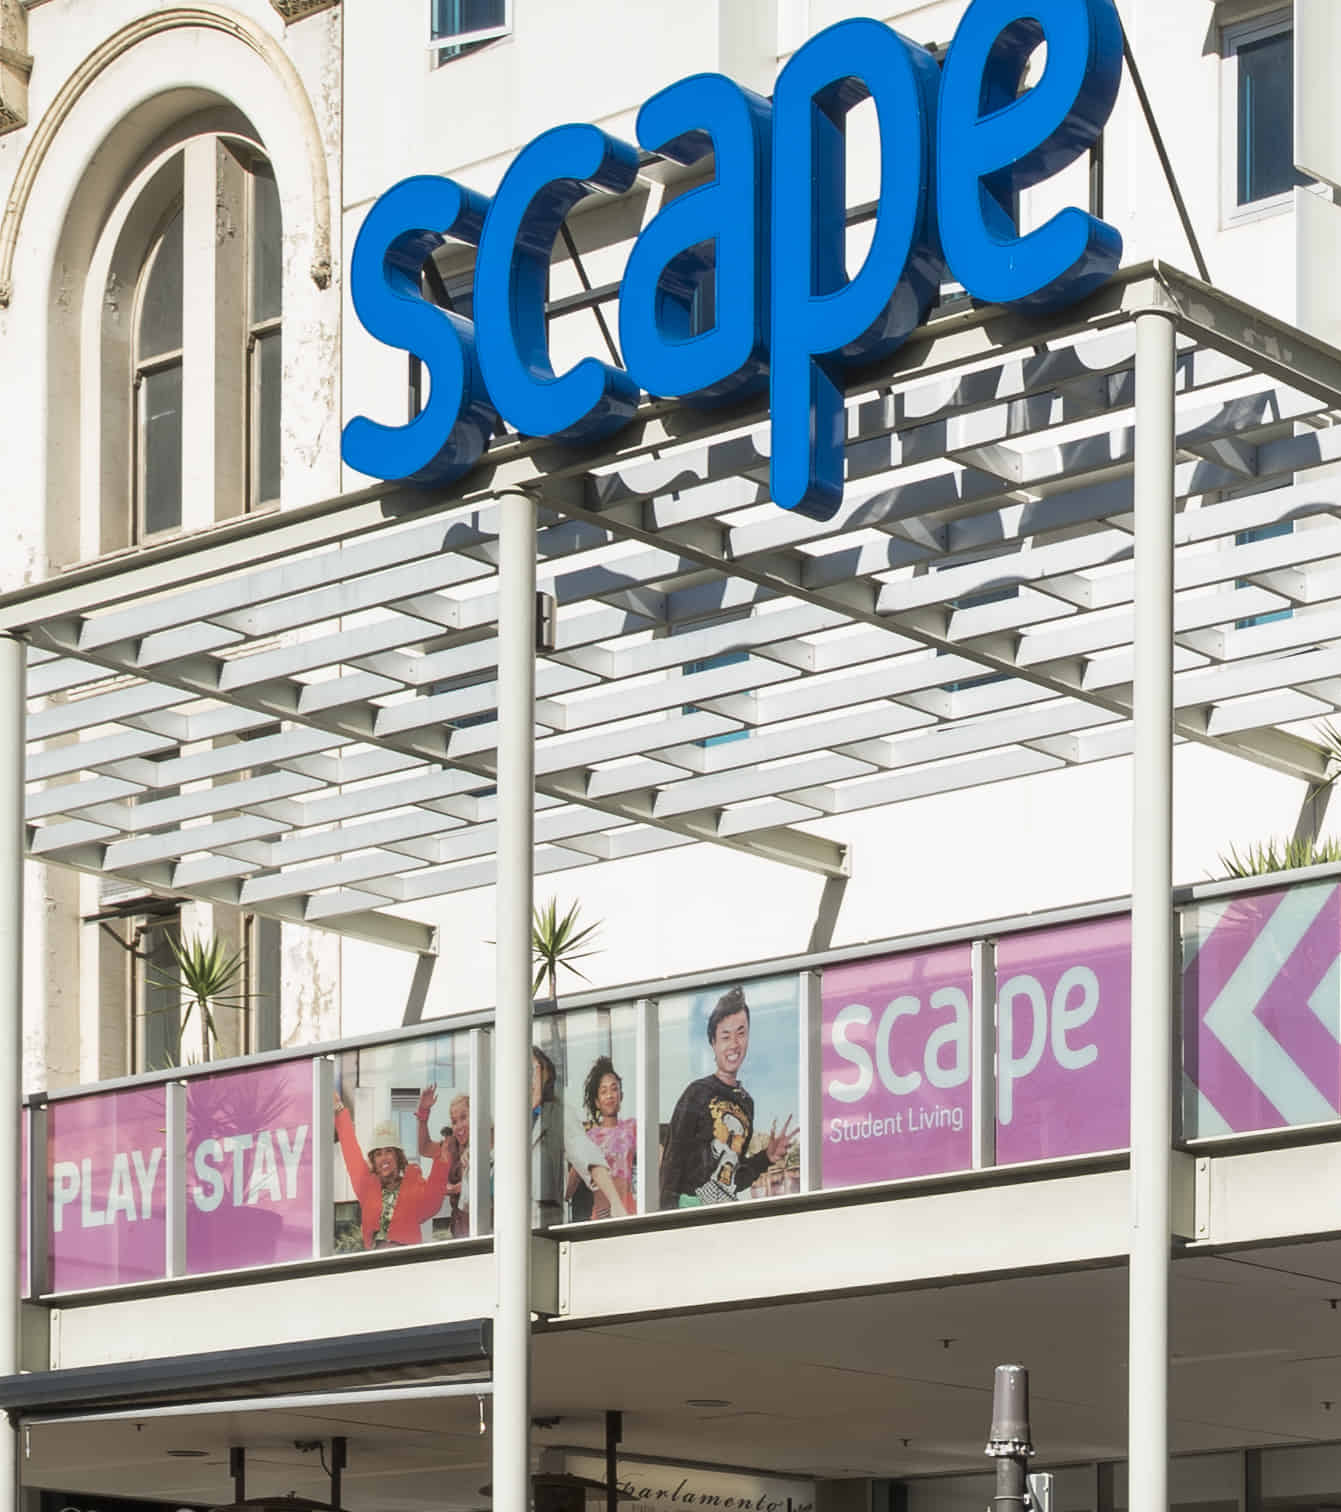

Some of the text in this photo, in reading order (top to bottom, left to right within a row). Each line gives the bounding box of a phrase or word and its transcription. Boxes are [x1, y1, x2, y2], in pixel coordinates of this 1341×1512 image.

[828, 964, 1100, 1126] scape
[829, 1105, 963, 1144] Student Living
[53, 1125, 308, 1233] PLAY STAY
